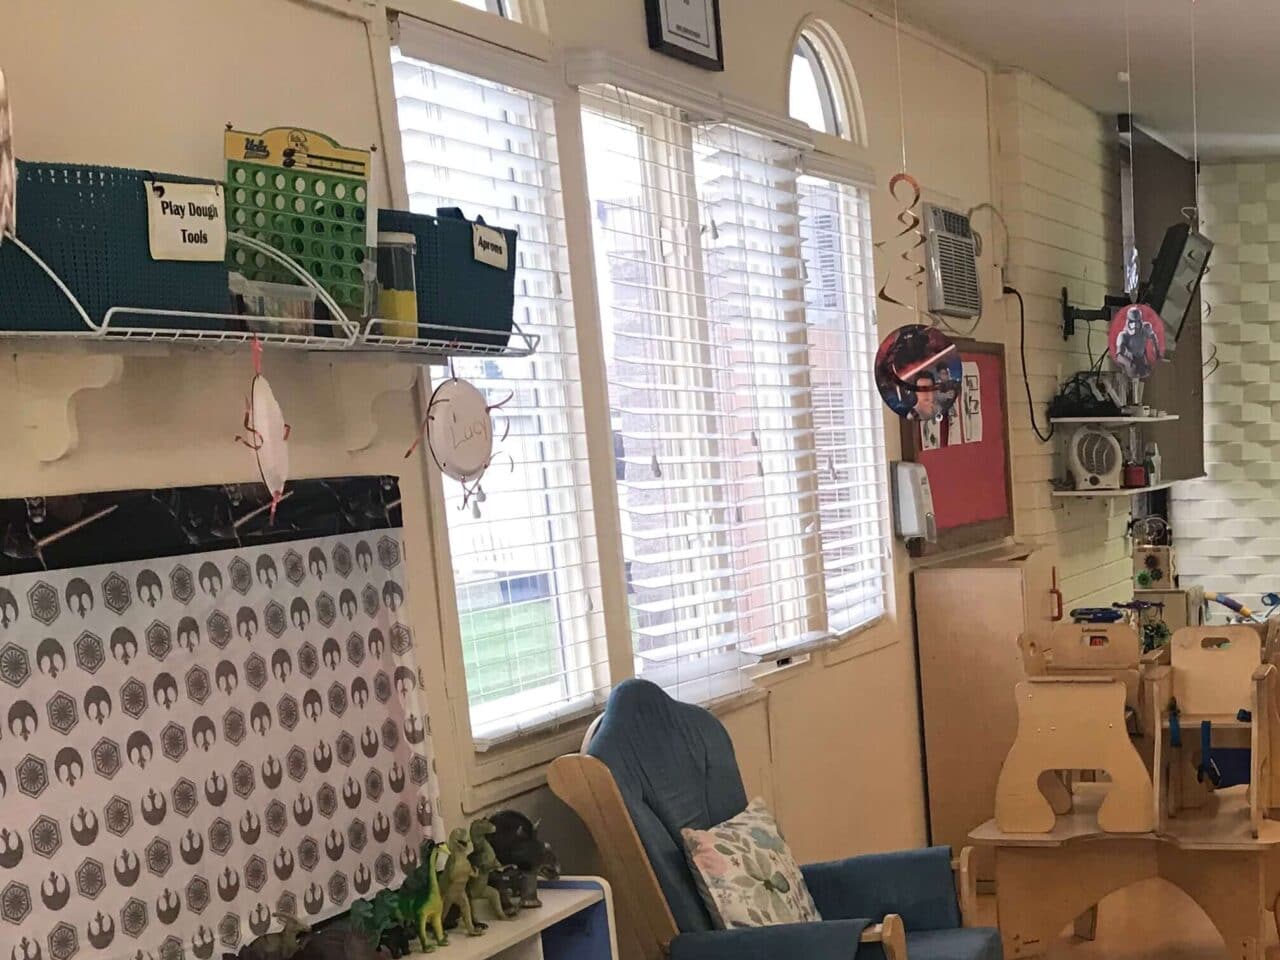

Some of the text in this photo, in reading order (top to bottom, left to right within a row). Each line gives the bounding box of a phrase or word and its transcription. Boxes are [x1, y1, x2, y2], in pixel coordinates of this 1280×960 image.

[161, 201, 219, 220] Play Dough
[181, 229, 208, 244] Tools
[450, 419, 488, 450] Lucy
